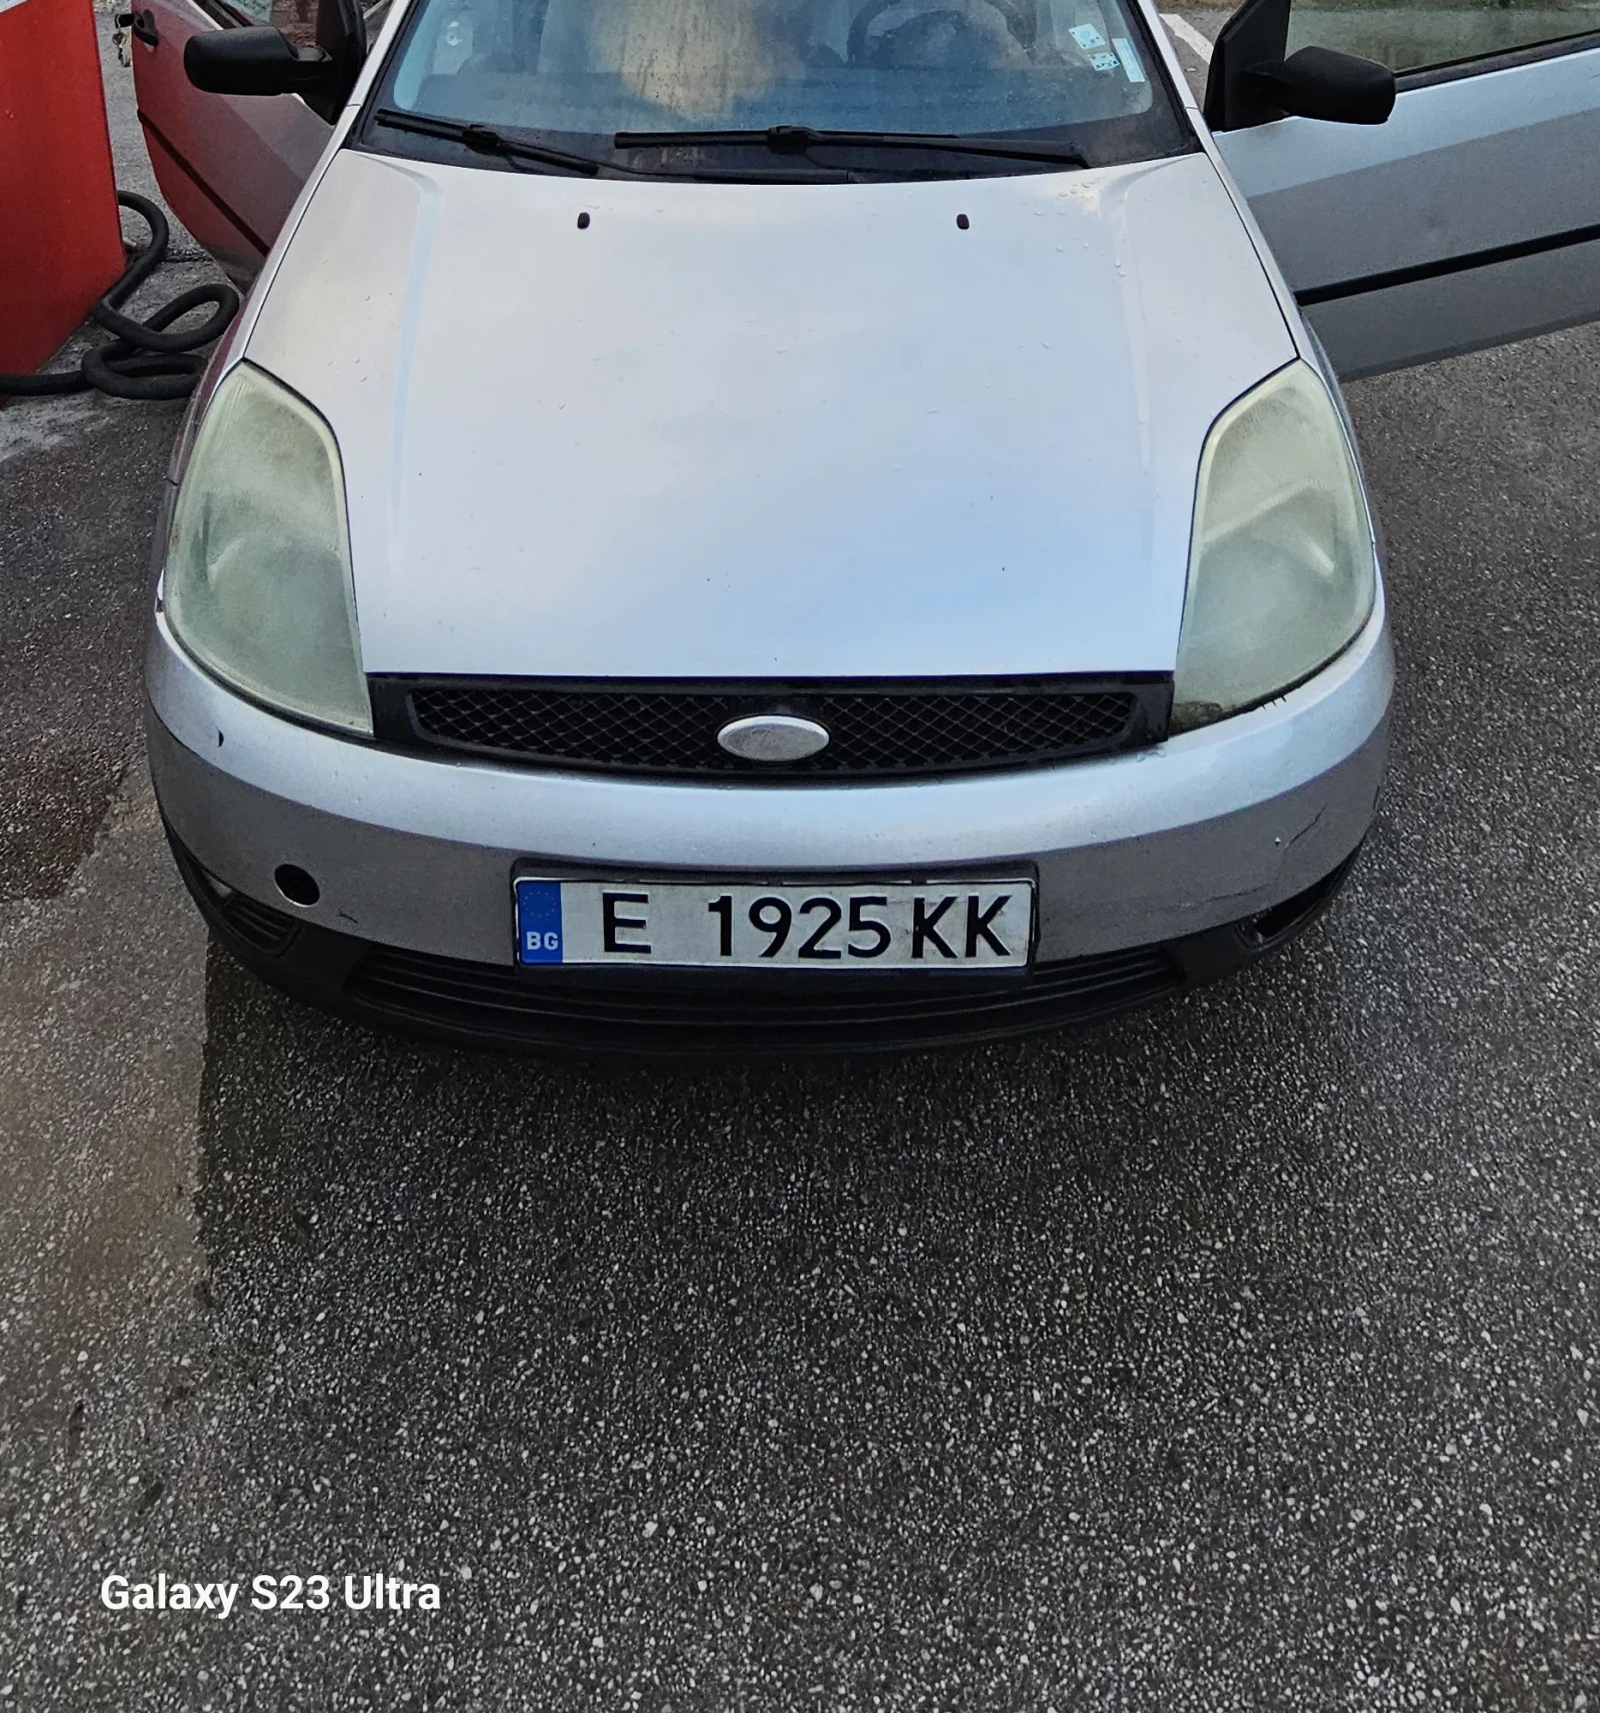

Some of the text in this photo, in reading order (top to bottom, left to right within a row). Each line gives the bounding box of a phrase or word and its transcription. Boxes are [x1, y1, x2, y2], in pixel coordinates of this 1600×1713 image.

[526, 931, 559, 950] BG
[602, 892, 1011, 960] E 1925 KK
